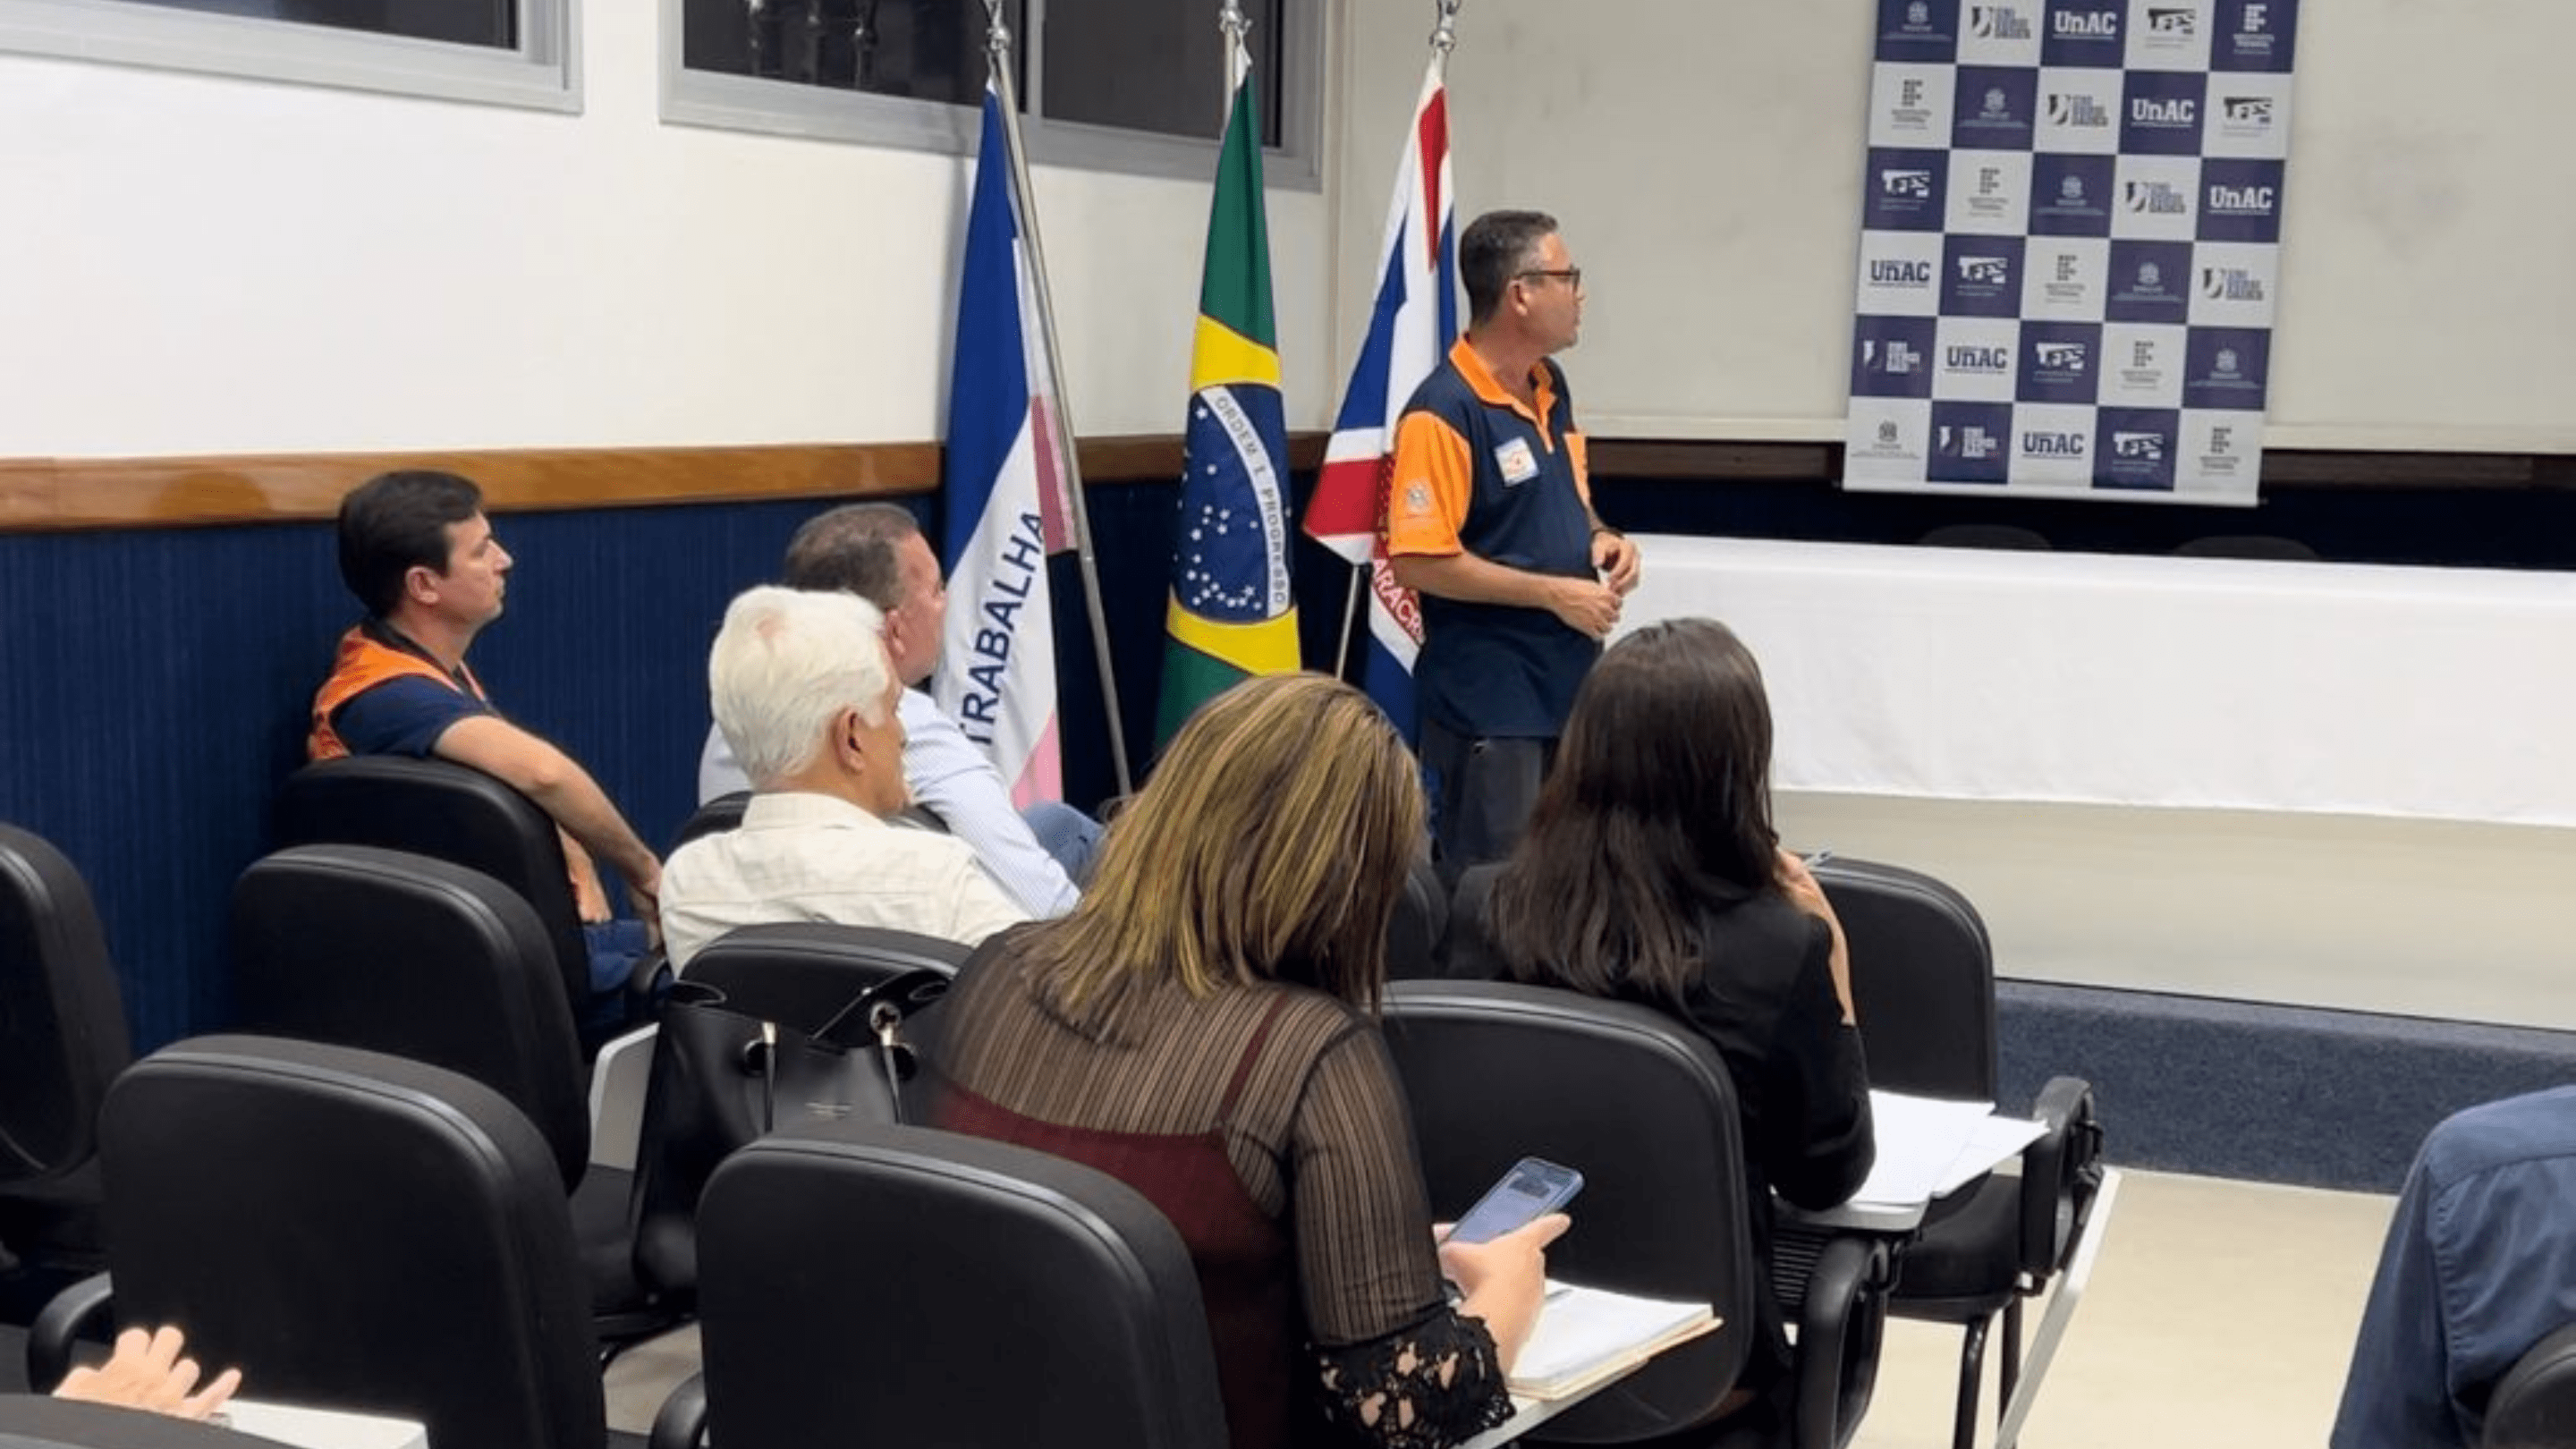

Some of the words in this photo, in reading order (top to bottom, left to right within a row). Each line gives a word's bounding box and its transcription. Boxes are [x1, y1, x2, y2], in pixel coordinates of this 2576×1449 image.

[2054, 11, 2117, 34] UnAC
[2132, 98, 2195, 122] UnAC
[2209, 186, 2273, 209] UnAC
[1870, 259, 1931, 283] UnAC
[1945, 345, 2008, 369] UnAC
[2022, 430, 2084, 454] UnAC
